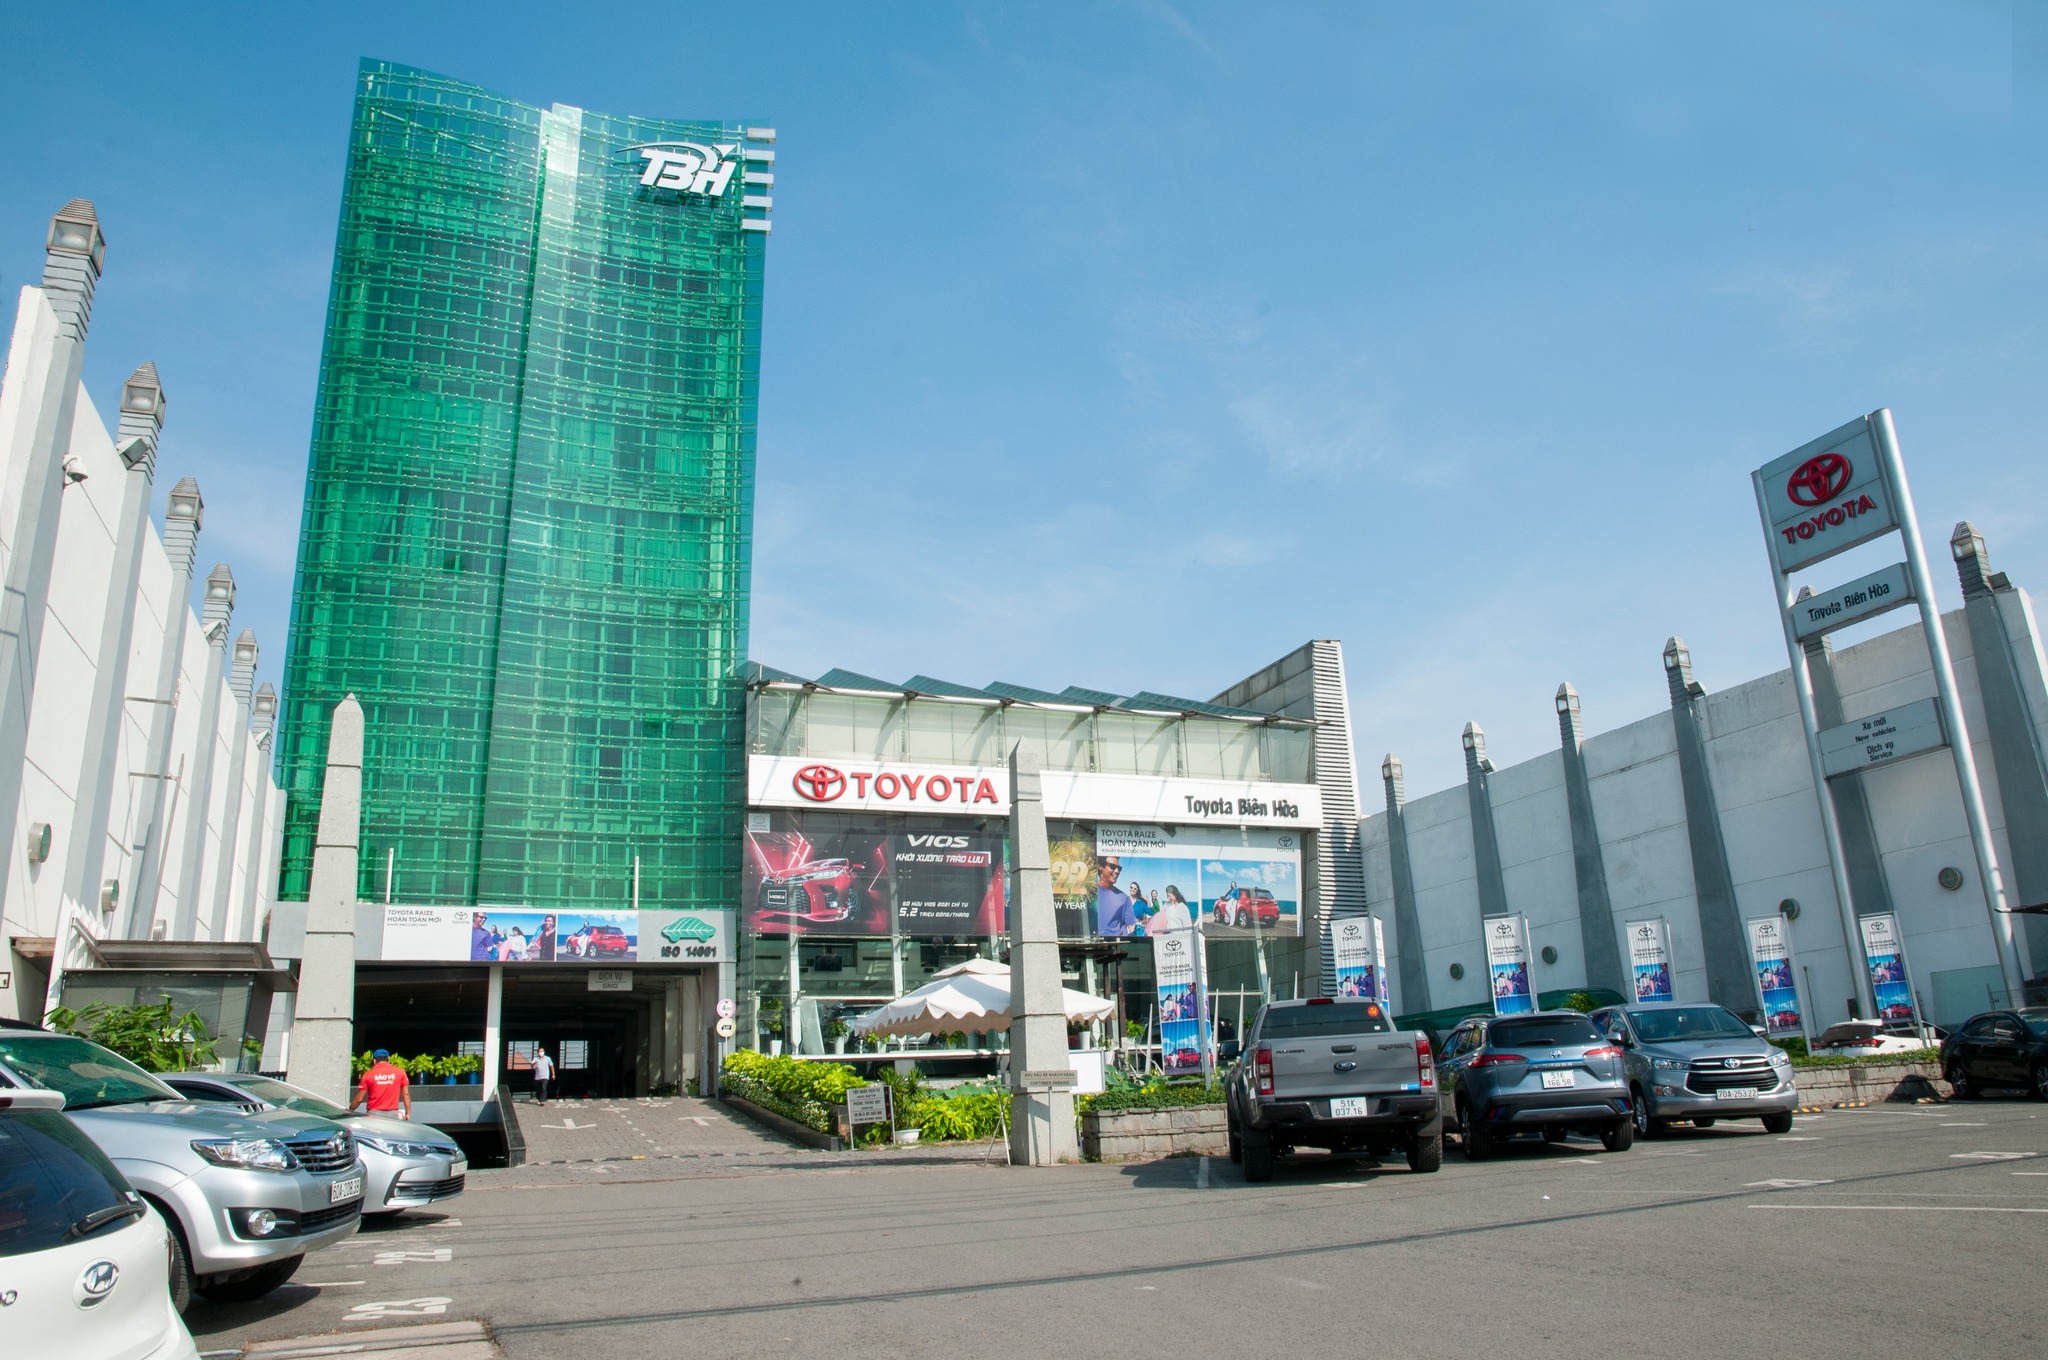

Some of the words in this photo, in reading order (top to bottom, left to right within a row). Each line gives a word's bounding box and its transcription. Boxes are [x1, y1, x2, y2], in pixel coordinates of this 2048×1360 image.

[640, 148, 737, 197] TBH
[1781, 494, 1876, 545] TOYOTA
[1808, 601, 1842, 622] Toyota
[1843, 591, 1868, 609] Biên
[1868, 583, 1891, 600] Hòa
[1861, 721, 1872, 731] Xe
[1855, 734, 1870, 743] New
[1872, 726, 1897, 738] vehicles
[1869, 751, 1893, 762] Service
[850, 772, 999, 804] TOYOTA
[1184, 795, 1233, 818] Toyota
[1237, 797, 1268, 817] Biên
[1272, 799, 1299, 819] Hòa
[1101, 829, 1133, 838] TOYOTA
[1134, 830, 1156, 839] RAIZE
[907, 834, 970, 848] VIOS
[1101, 838, 1126, 847] HOÀN
[1126, 838, 1149, 848] TOÀN
[1051, 860, 1089, 894] 22
[1064, 901, 1087, 910] YEAR
[899, 907, 919, 918] 5,2
[660, 945, 681, 958] ISO
[685, 945, 717, 958] 14001
[1163, 950, 1186, 958] TOYOTA
[1550, 1071, 1565, 1080] 51K
[1340, 1099, 1356, 1108] 51K
[1335, 1107, 1363, 1116] 037.16
